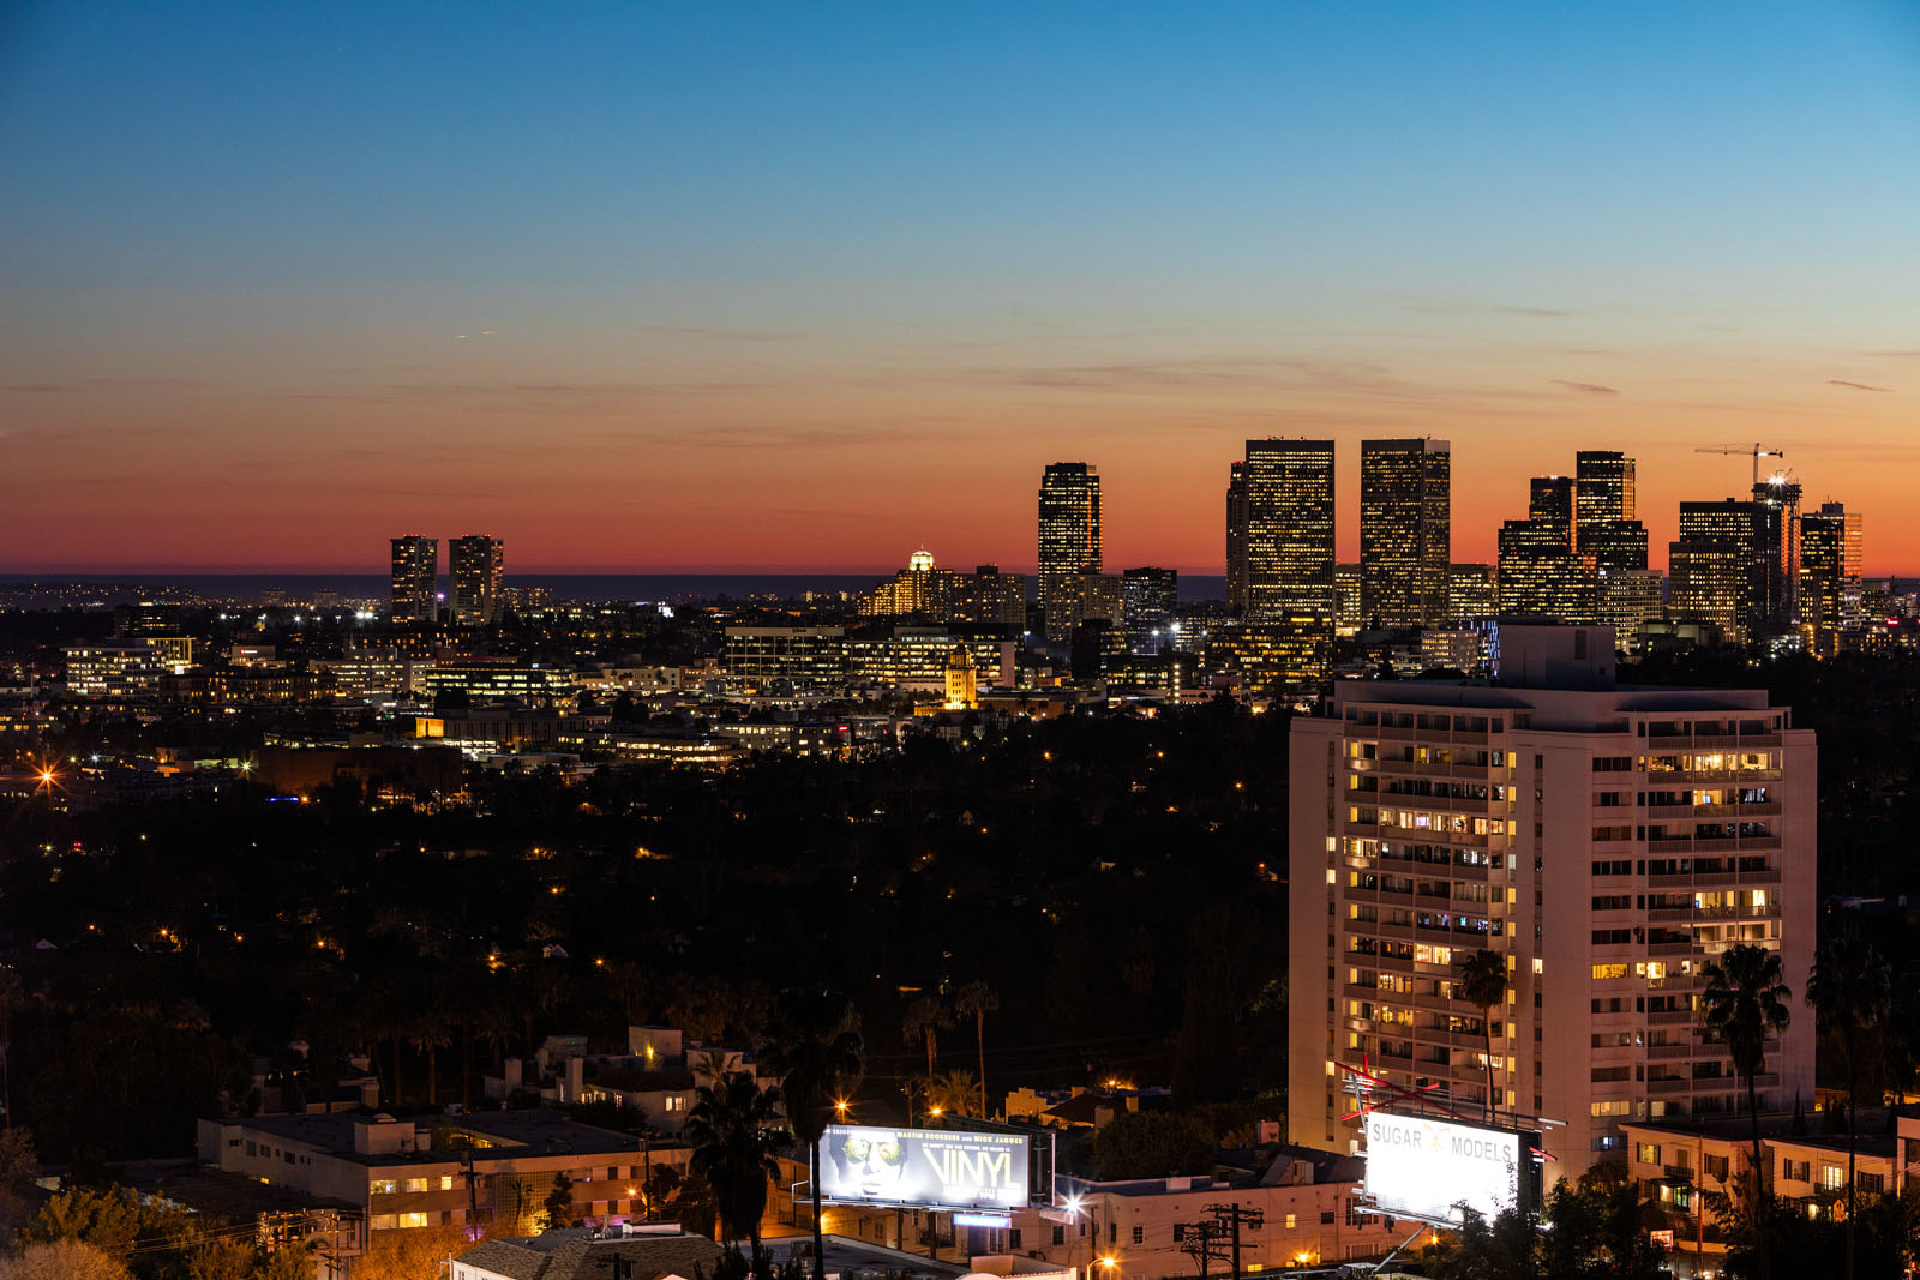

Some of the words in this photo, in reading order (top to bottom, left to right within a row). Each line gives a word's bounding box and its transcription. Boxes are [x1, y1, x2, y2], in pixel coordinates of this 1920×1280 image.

[1374, 1123, 1422, 1148] SUGAR
[1452, 1136, 1511, 1162] MODELS
[923, 1148, 1021, 1189] VINYL
